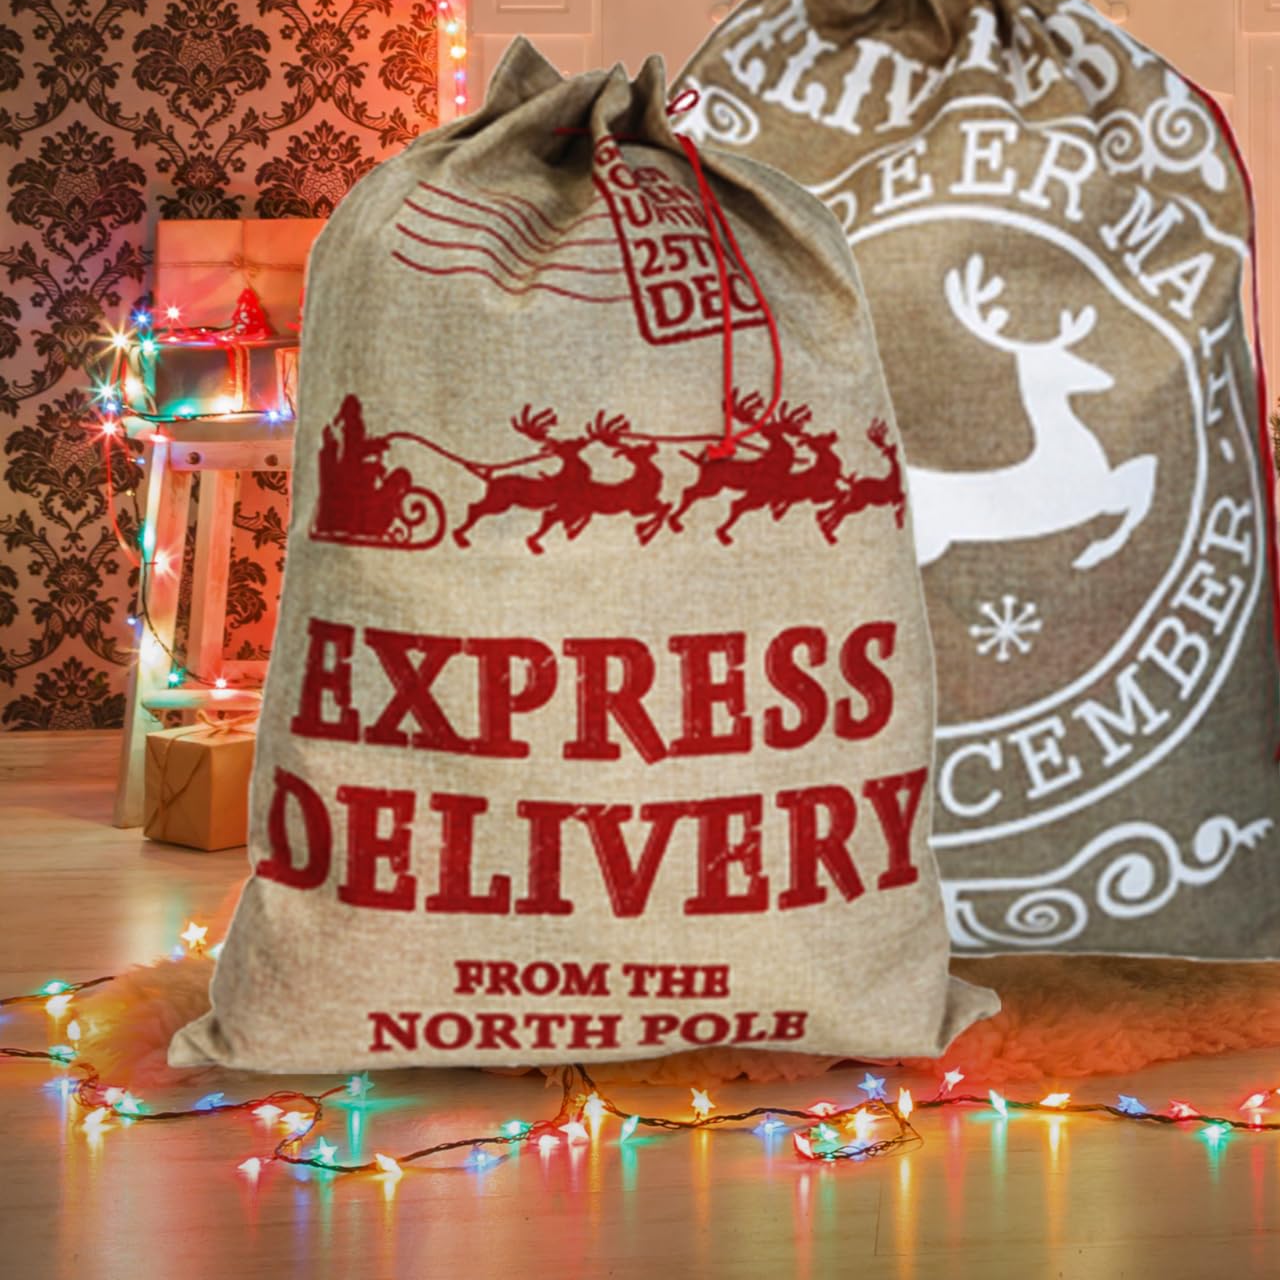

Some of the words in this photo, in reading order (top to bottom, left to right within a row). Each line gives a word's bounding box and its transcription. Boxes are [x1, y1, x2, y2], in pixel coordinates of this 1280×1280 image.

[646, 273, 763, 329] DEC
[290, 617, 898, 765] EXPRESS
[255, 765, 928, 917] DELIVERY
[453, 959, 611, 998] FROM
[622, 963, 730, 999] THE
[368, 1011, 622, 1051] NORTH
[636, 1010, 809, 1047] POLE
